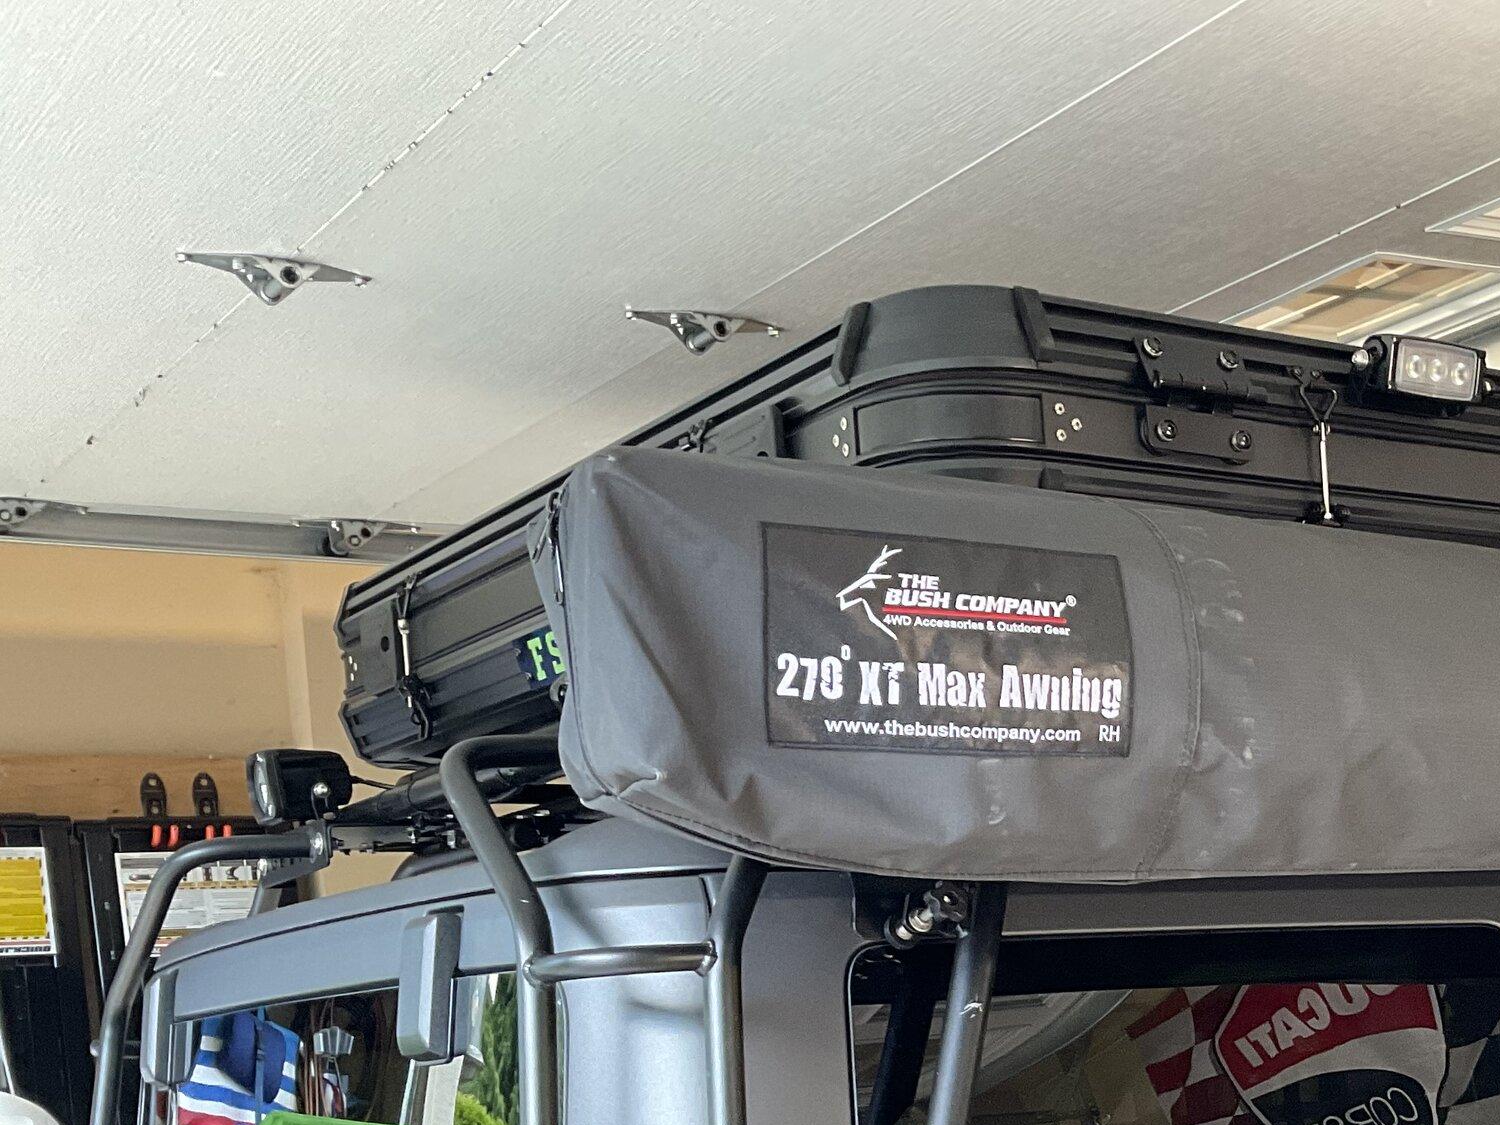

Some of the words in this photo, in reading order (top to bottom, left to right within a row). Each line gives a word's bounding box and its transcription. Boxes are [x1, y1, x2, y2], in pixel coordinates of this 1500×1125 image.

[898, 572, 940, 590] THE
[884, 588, 951, 609] BUSH
[883, 613, 912, 626] 4WD
[914, 616, 985, 632] Accessories
[986, 620, 996, 632] &
[996, 620, 1043, 634] Outdoor
[1043, 625, 1071, 636] Gear
[858, 661, 905, 705] XT
[917, 662, 986, 707] Max
[1000, 664, 1122, 719] Awning
[824, 718, 1081, 743] www.thebushcompany.com
[1098, 724, 1121, 742] RH
